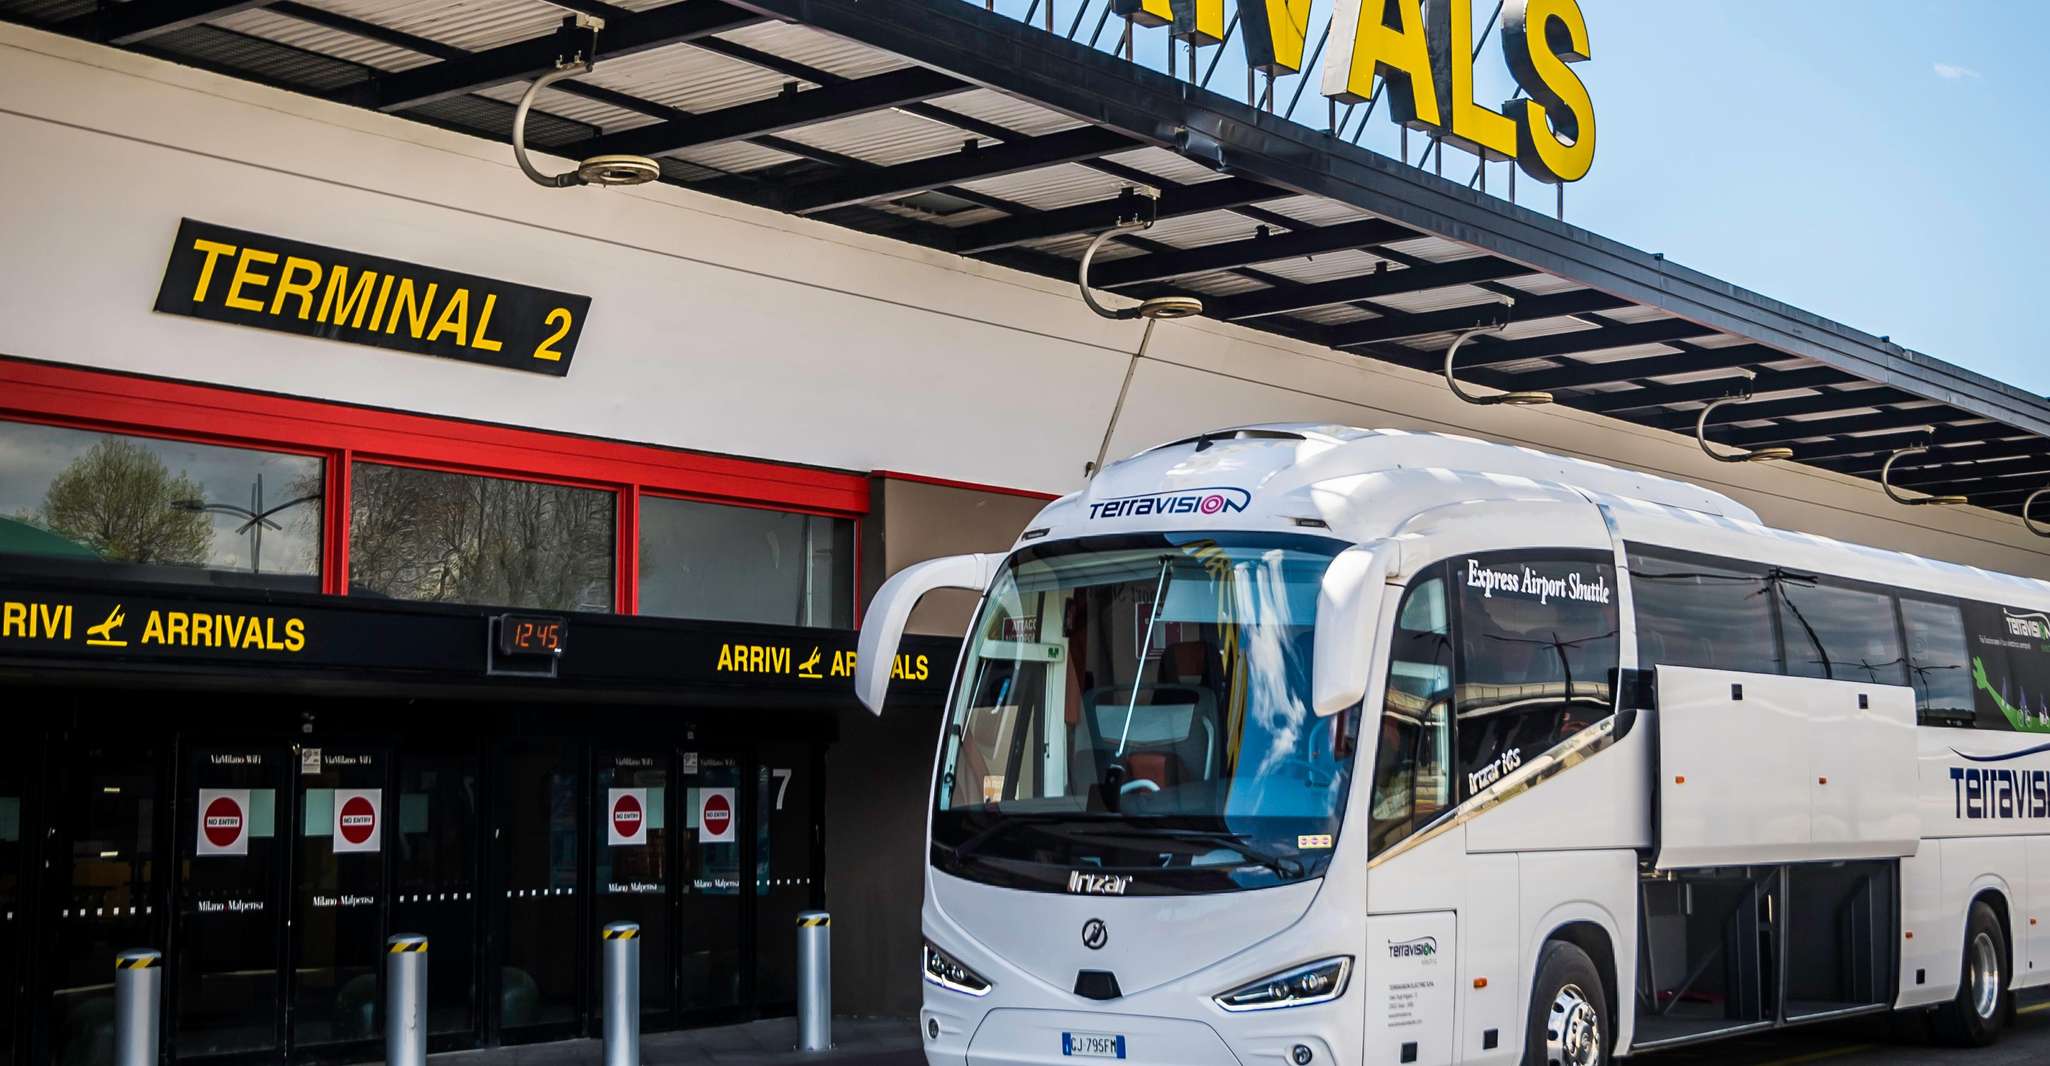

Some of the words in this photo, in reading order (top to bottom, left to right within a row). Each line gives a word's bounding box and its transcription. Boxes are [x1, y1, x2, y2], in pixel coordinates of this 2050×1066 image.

[193, 238, 503, 352] TERMINAL
[533, 307, 573, 362] 2
[1467, 559, 1519, 598] Express
[1520, 567, 1566, 605] Airport
[1568, 572, 1610, 604] Shuttle
[2, 601, 73, 640] RIVI
[141, 610, 305, 652] ARRIVALS
[717, 643, 791, 674] ARRIVI
[830, 650, 929, 681] ARALS
[772, 768, 792, 810] 7
[208, 818, 218, 826] NO
[218, 818, 239, 826] ENTRY
[343, 817, 353, 825] NO
[353, 817, 371, 825] ENTRY
[199, 901, 224, 911] Milano
[228, 900, 264, 912] Malpensa
[313, 896, 337, 906] Milano
[340, 895, 374, 907] Malpensa
